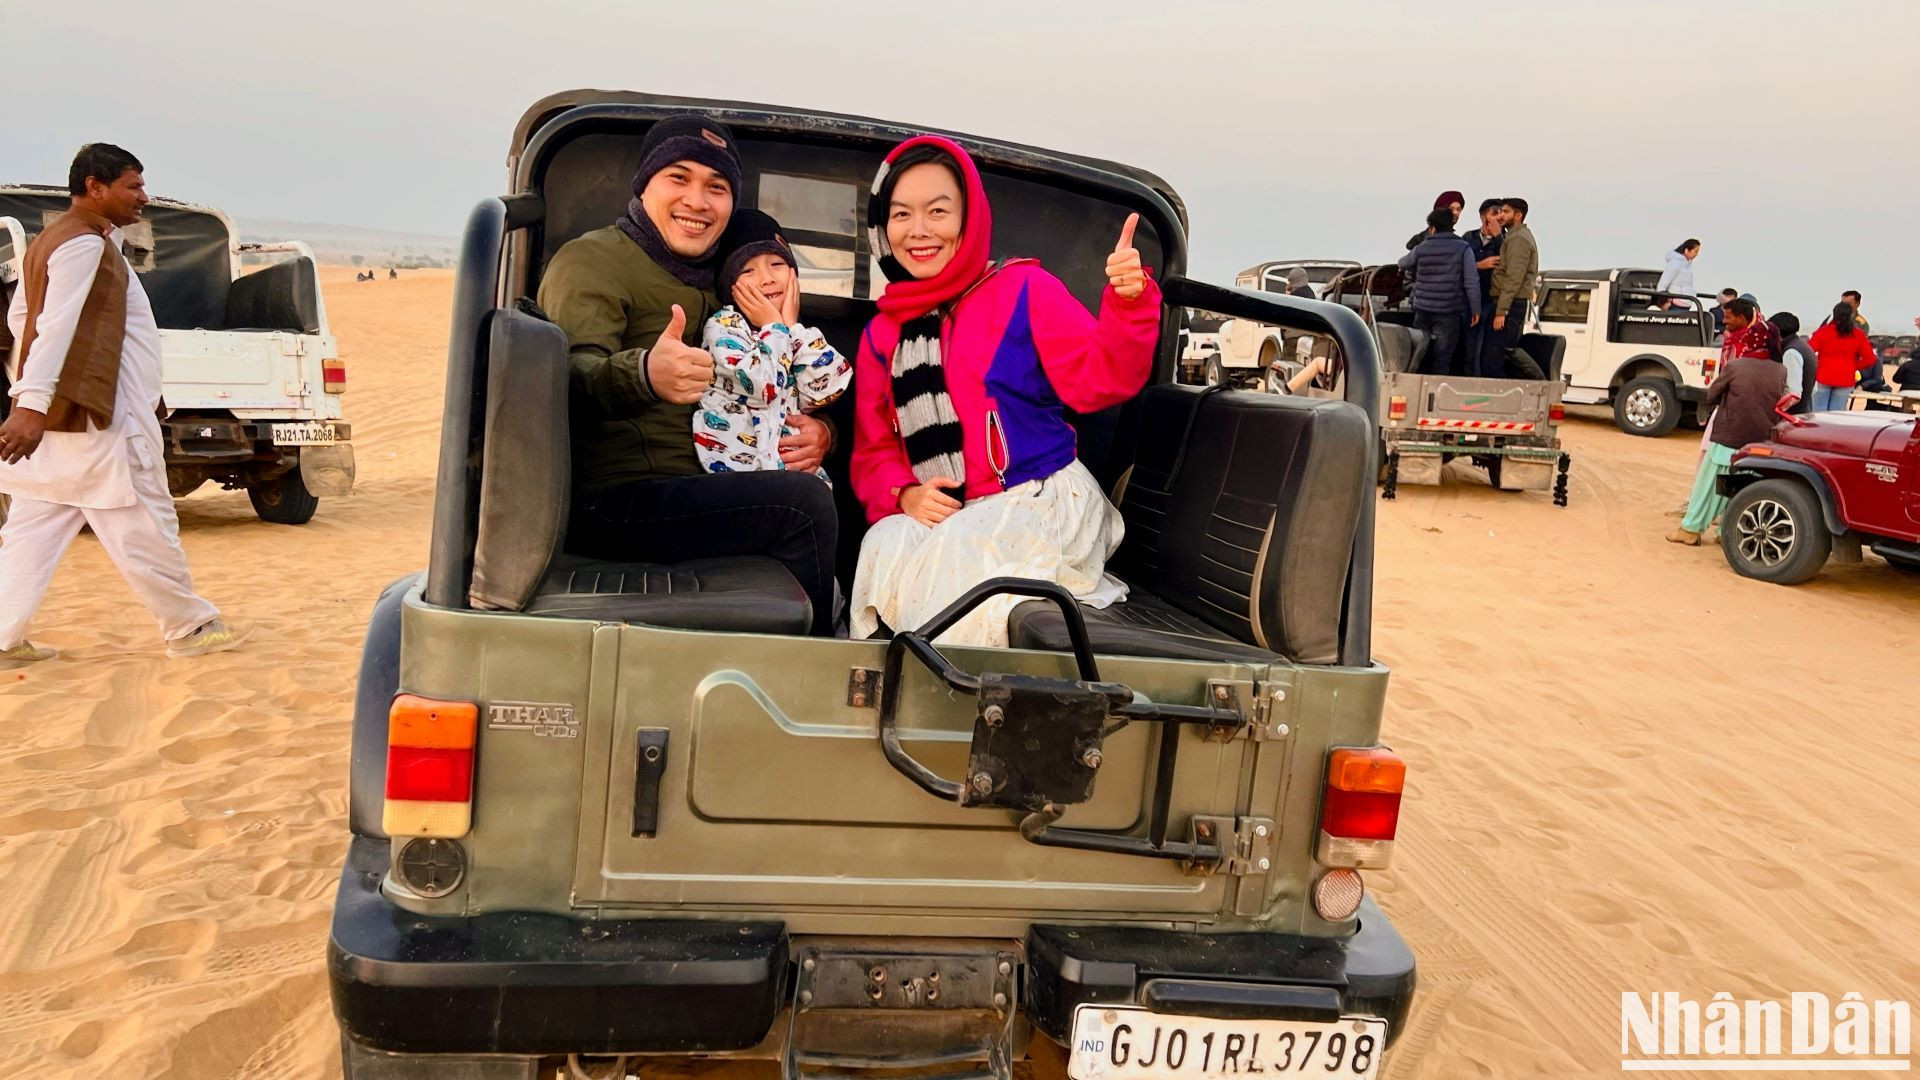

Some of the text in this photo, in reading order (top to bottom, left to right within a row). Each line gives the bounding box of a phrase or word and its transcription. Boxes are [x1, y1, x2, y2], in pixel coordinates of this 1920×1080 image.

[1626, 315, 1689, 325] Desert Jeep Safari
[275, 429, 333, 441] RJ21.TA.2068
[489, 705, 580, 725] THAR
[1079, 1039, 1104, 1053] IND
